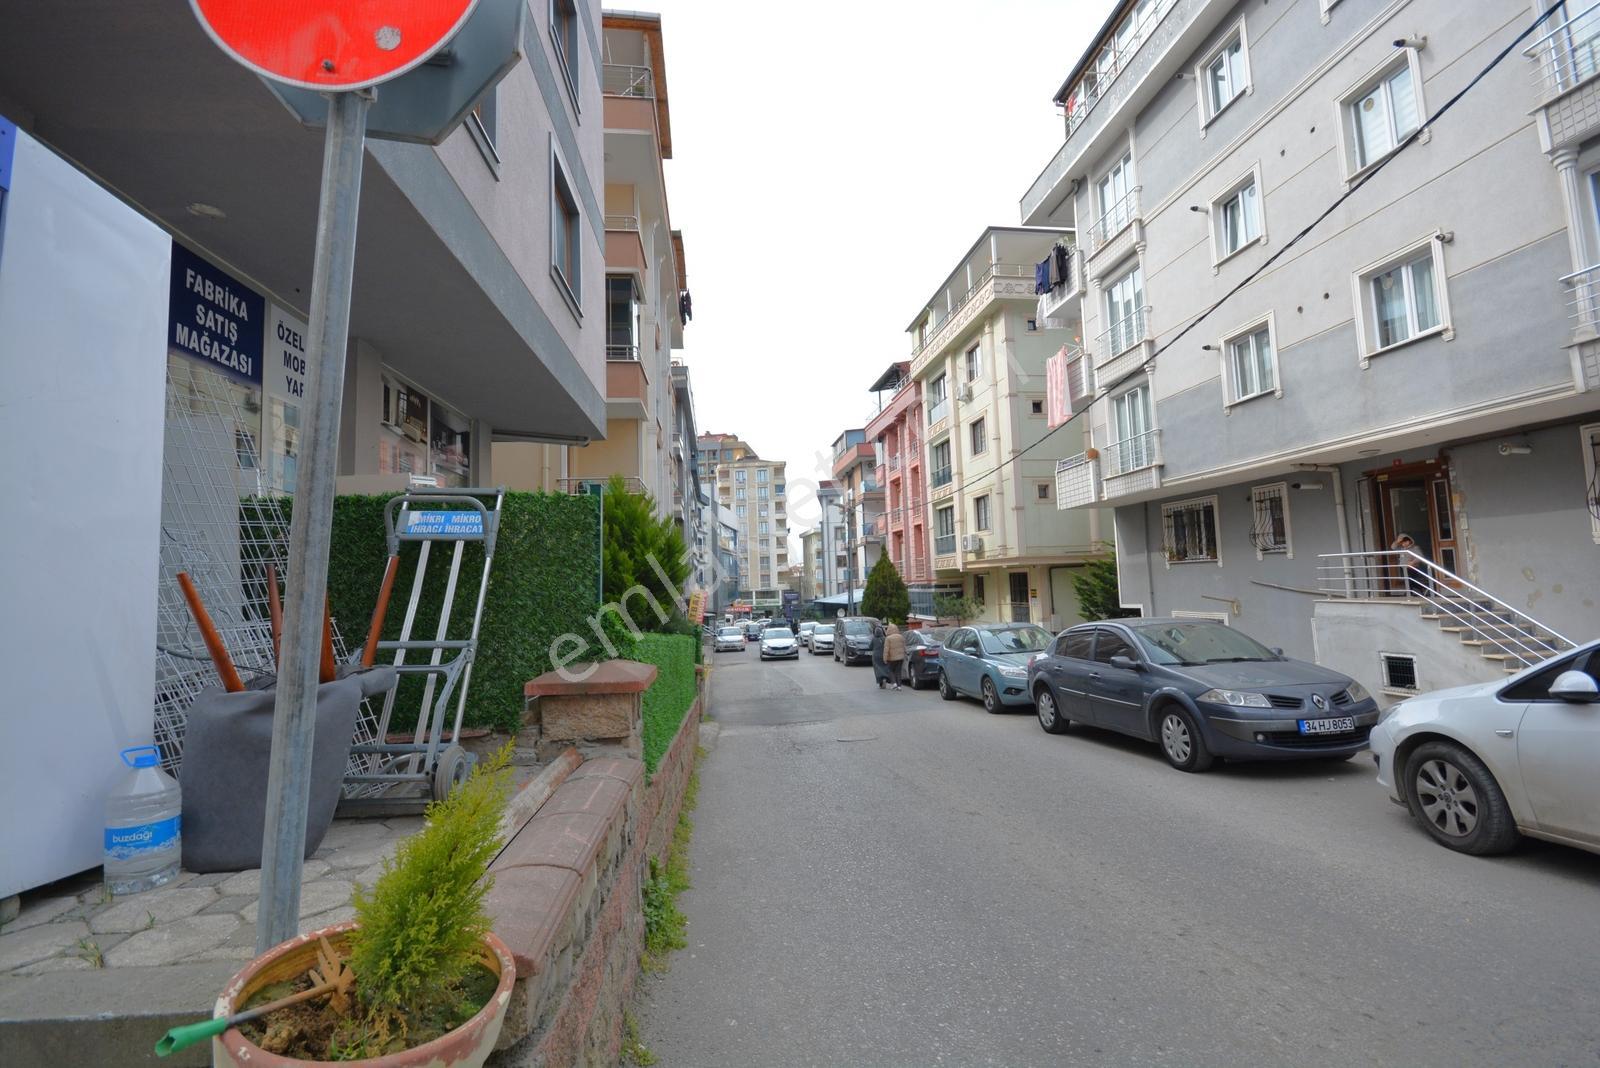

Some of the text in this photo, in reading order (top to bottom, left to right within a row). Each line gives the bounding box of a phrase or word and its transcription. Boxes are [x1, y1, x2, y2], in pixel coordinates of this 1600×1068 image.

[186, 268, 248, 321] FABRİKA
[195, 303, 238, 346] SATIŞ
[277, 319, 305, 352] ÖZEL
[175, 322, 252, 376] MAĞAZASI
[1304, 721, 1317, 732] 34
[1318, 720, 1331, 731] HJ
